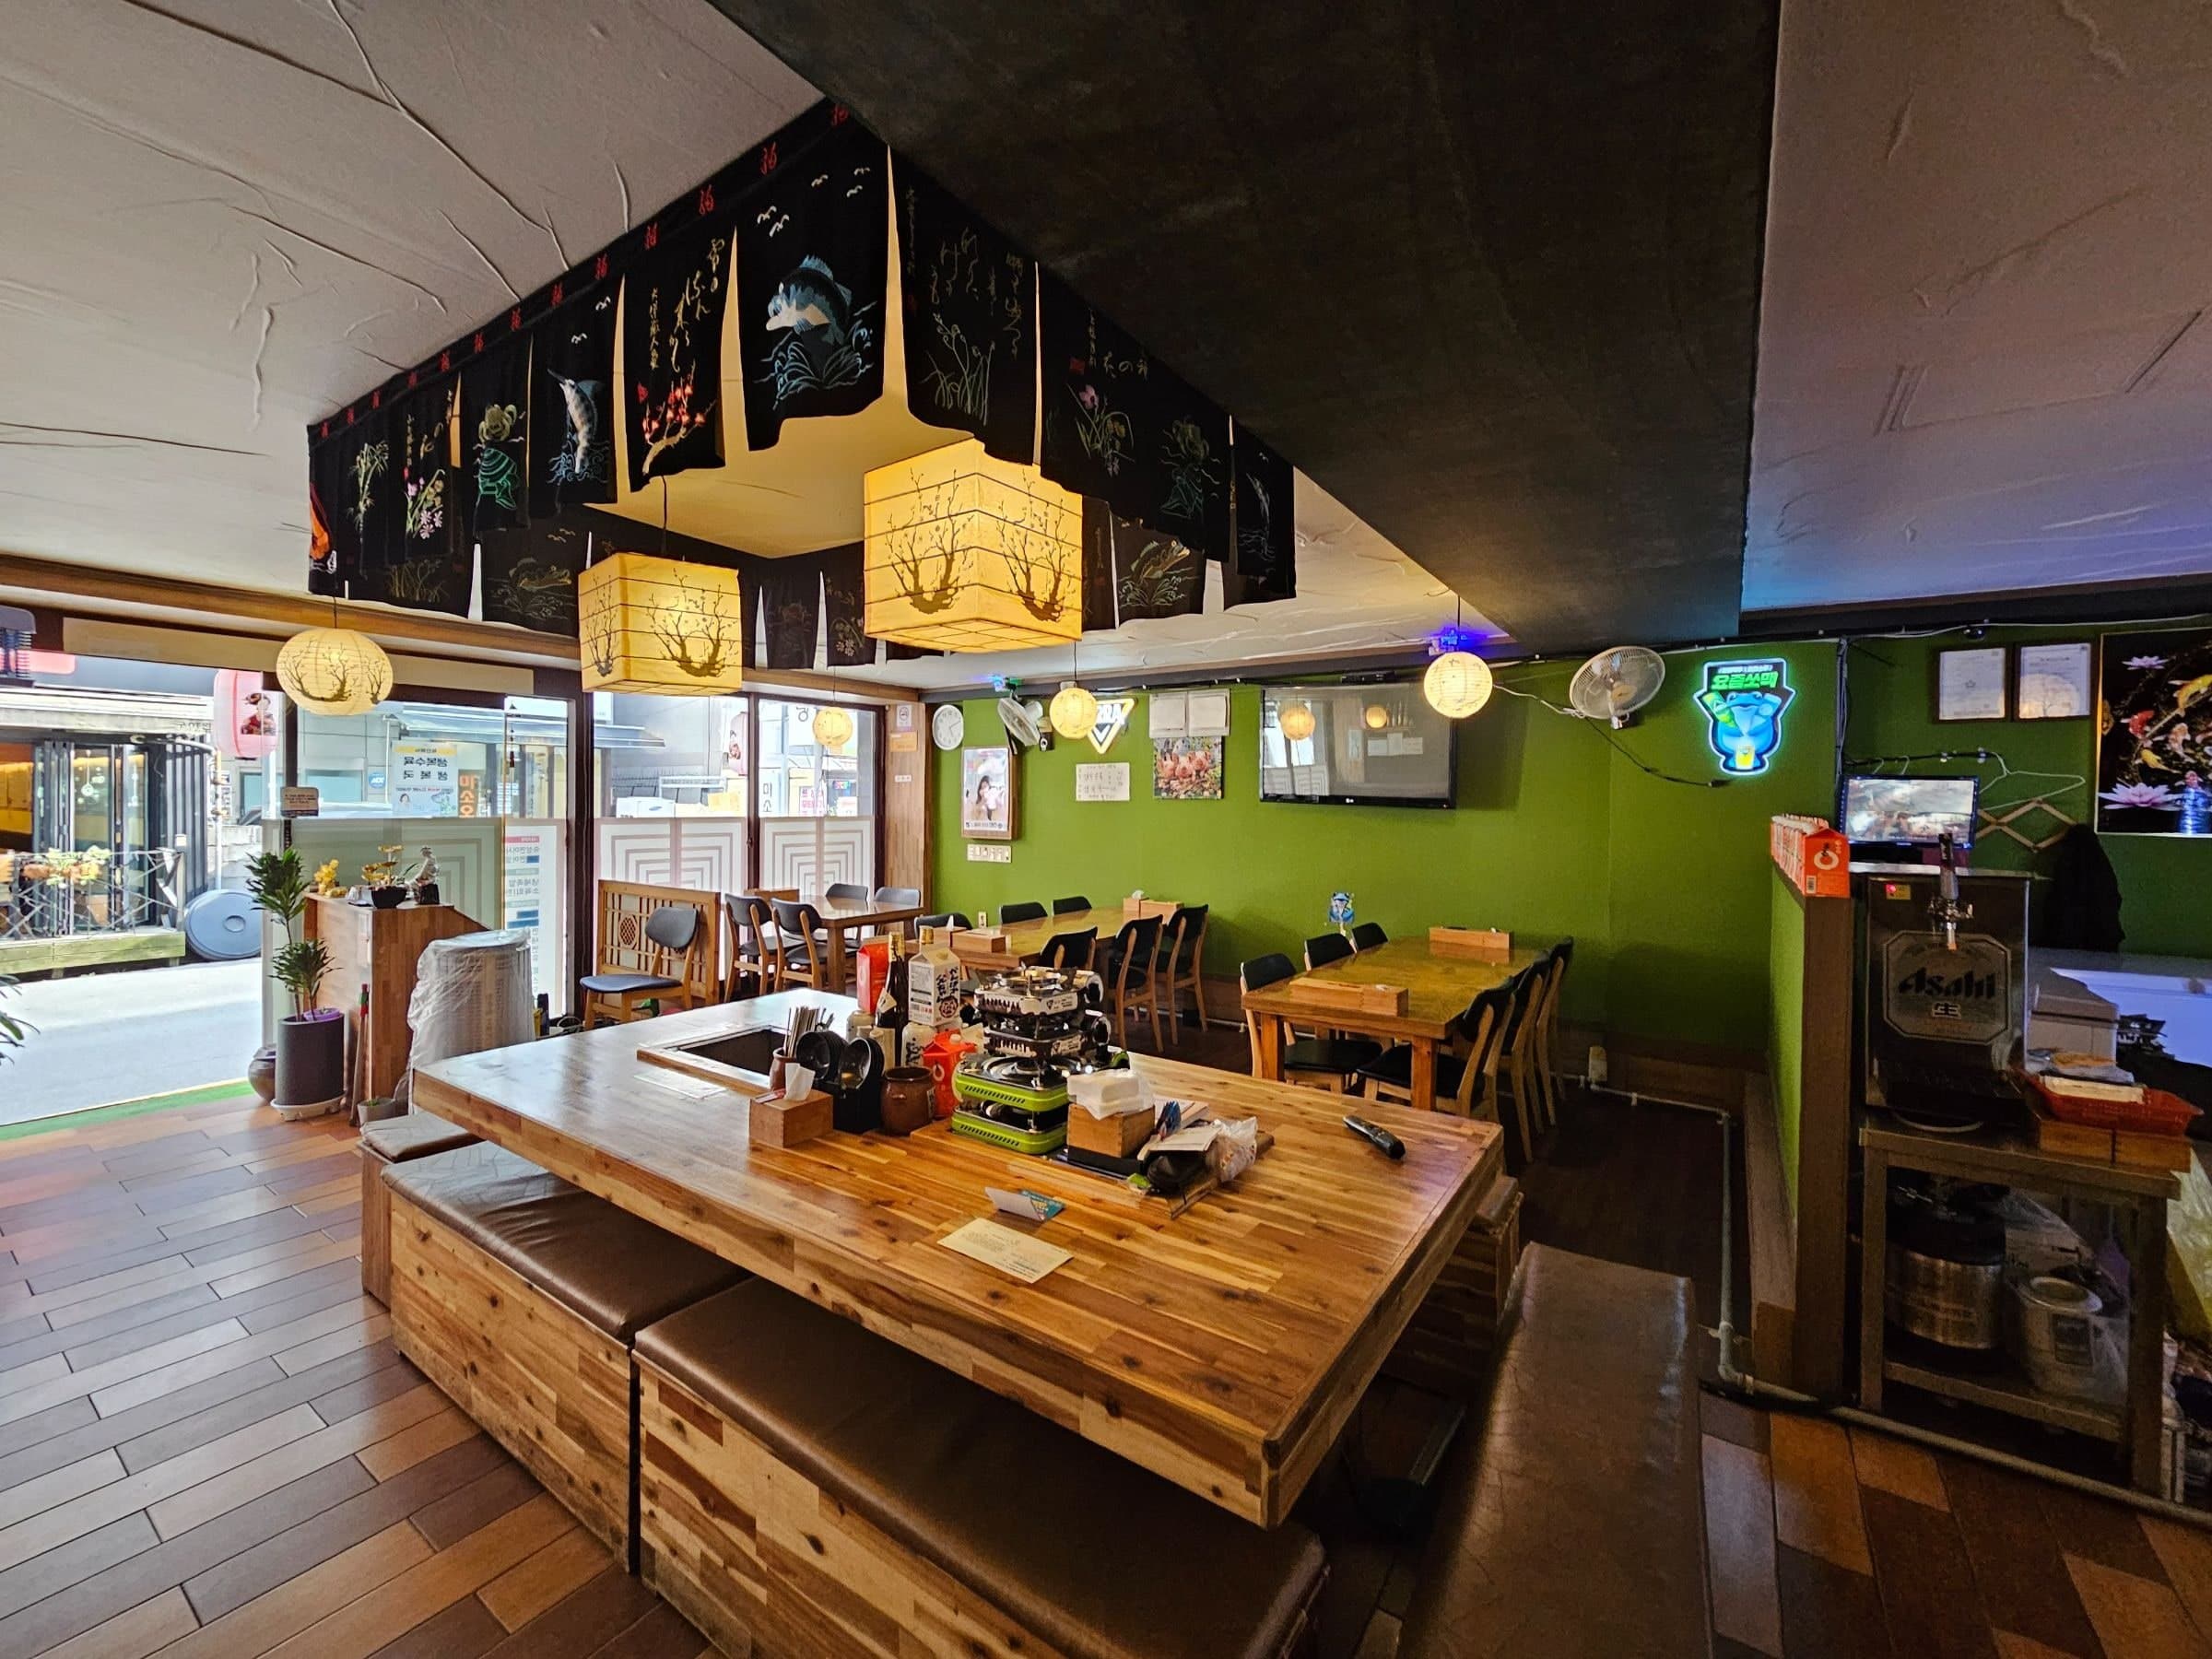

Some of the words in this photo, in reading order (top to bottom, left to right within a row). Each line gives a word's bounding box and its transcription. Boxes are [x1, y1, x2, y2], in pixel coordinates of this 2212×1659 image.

[1712, 671, 1778, 689] 요즘쏘맥
[1899, 967, 1996, 999] Asahi
[1933, 1001, 1961, 1019] 生
